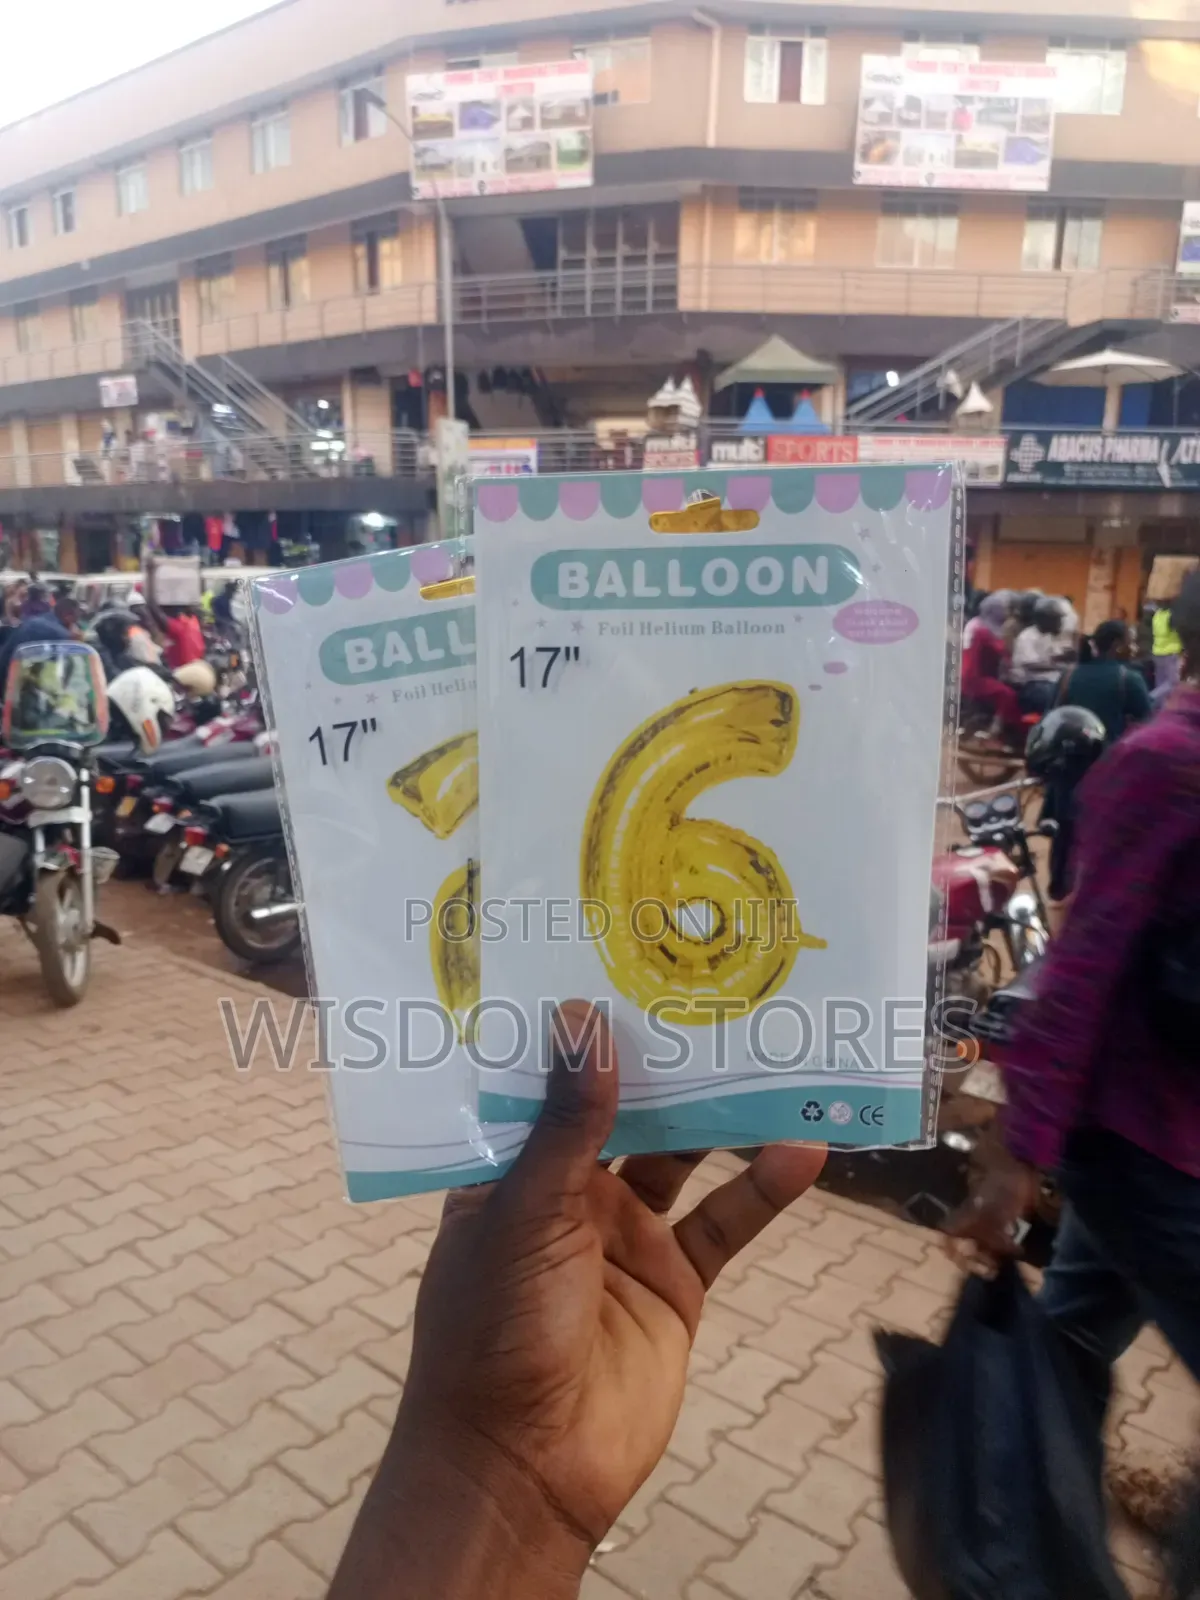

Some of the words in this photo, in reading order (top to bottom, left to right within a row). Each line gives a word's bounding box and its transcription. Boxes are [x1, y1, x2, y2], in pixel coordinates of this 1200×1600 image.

[772, 438, 854, 463] SPORTS
[557, 555, 829, 598] BALLOON
[598, 621, 635, 637] Foil
[639, 620, 707, 637] Helium
[711, 619, 786, 636] Balloon
[508, 645, 580, 689] 17"
[391, 684, 428, 703] Foil
[308, 716, 378, 766] 17"
